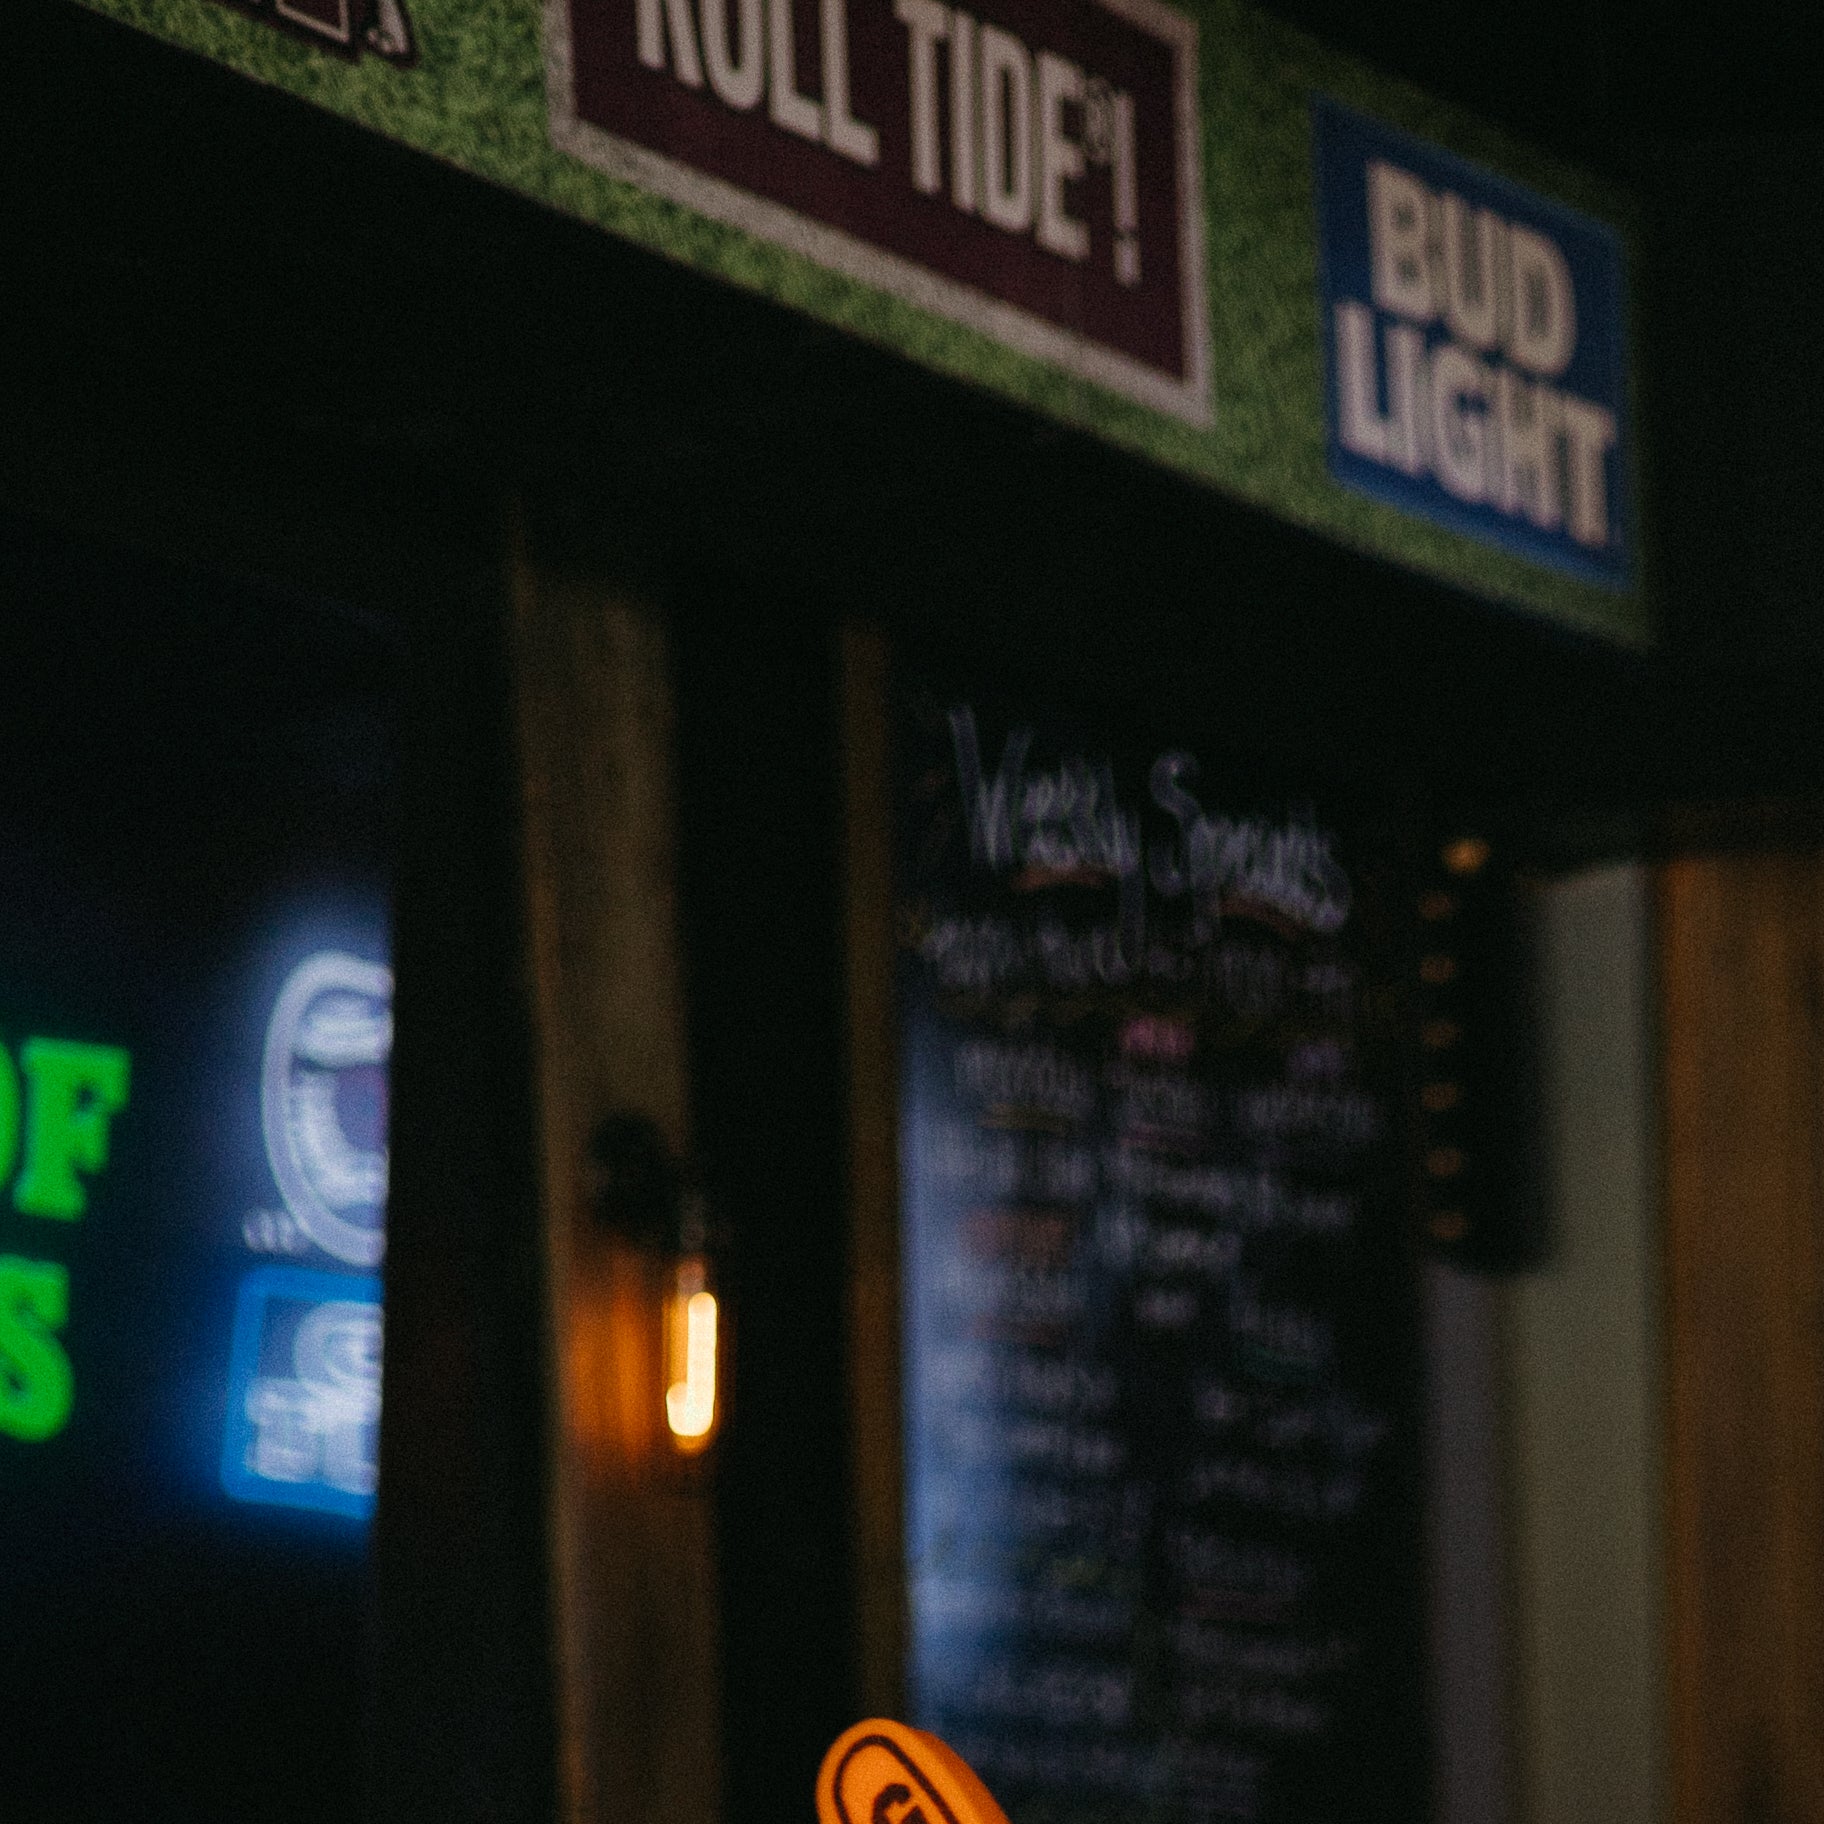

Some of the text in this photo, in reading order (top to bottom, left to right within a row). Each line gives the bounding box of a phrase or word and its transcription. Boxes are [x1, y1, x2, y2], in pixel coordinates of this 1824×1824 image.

[1367, 160, 1578, 377] BUD
[1334, 299, 1617, 548] LIGHT
[0, 1034, 131, 1222] F
